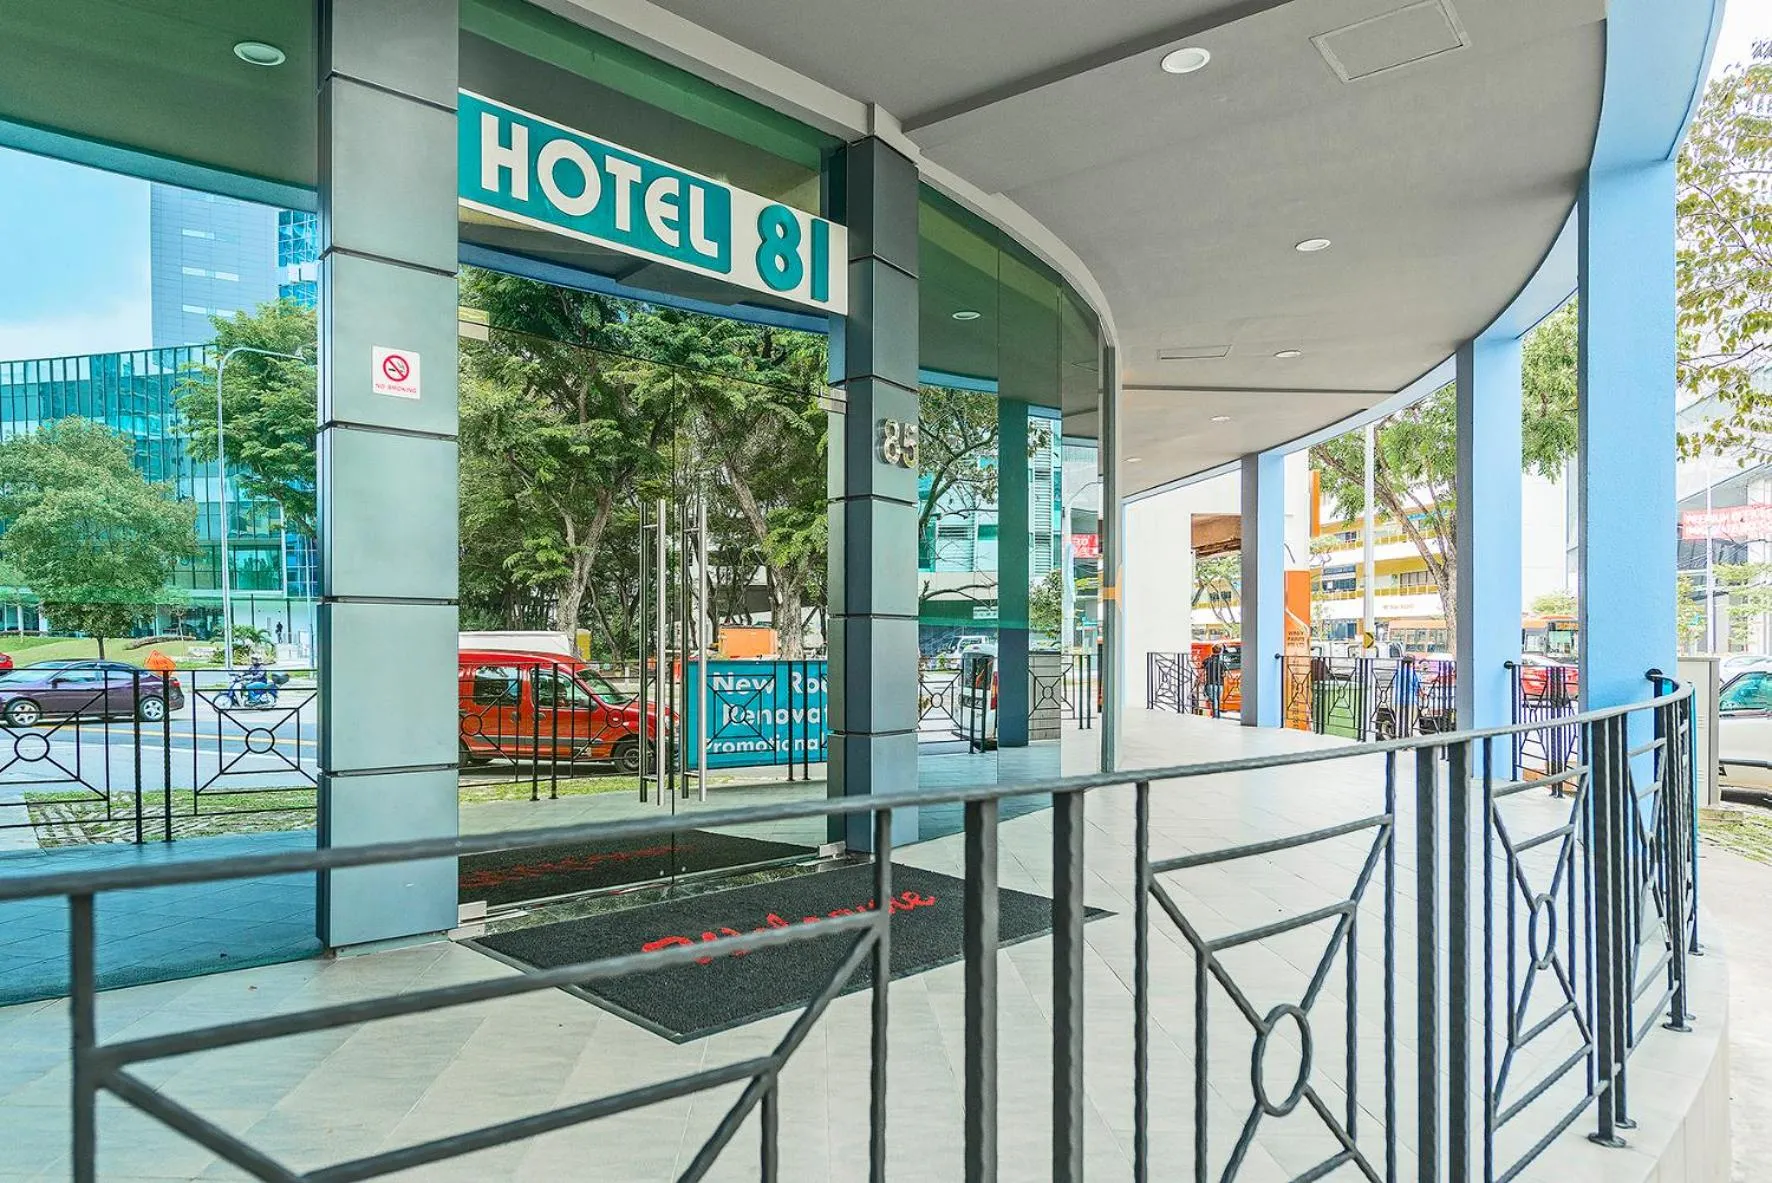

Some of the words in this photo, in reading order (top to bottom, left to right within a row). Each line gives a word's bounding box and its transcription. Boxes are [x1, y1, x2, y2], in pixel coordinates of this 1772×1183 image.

[480, 111, 719, 259] HOTEL
[755, 204, 831, 303] 81
[388, 384, 416, 393] SMOKING
[881, 418, 920, 469] 85
[713, 672, 775, 695] New
